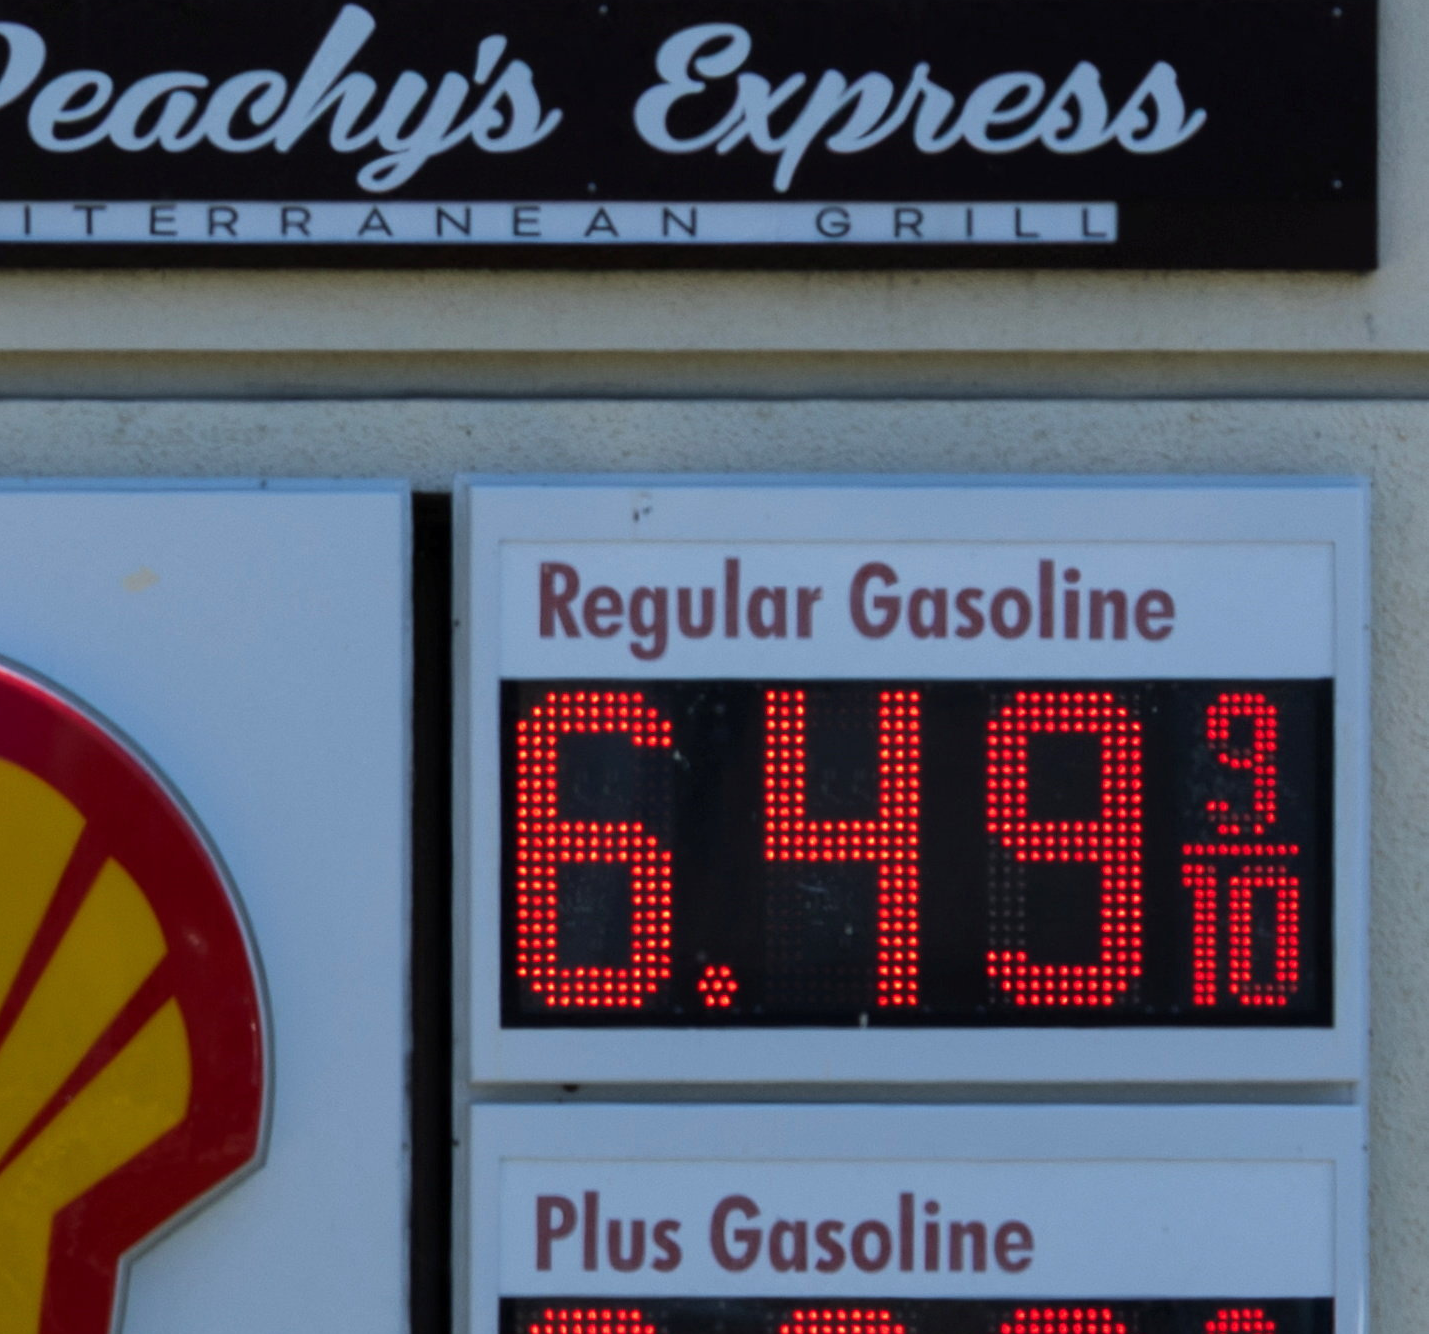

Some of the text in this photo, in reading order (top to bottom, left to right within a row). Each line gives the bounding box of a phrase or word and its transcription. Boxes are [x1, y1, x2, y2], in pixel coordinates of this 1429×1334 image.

[633, 22, 1208, 193] Express
[814, 204, 1107, 240] GRILL
[537, 557, 1177, 662] Regular Gasoline
[514, 688, 1145, 1010] 6.49
[534, 1190, 1036, 1274] Plus Gasoline
